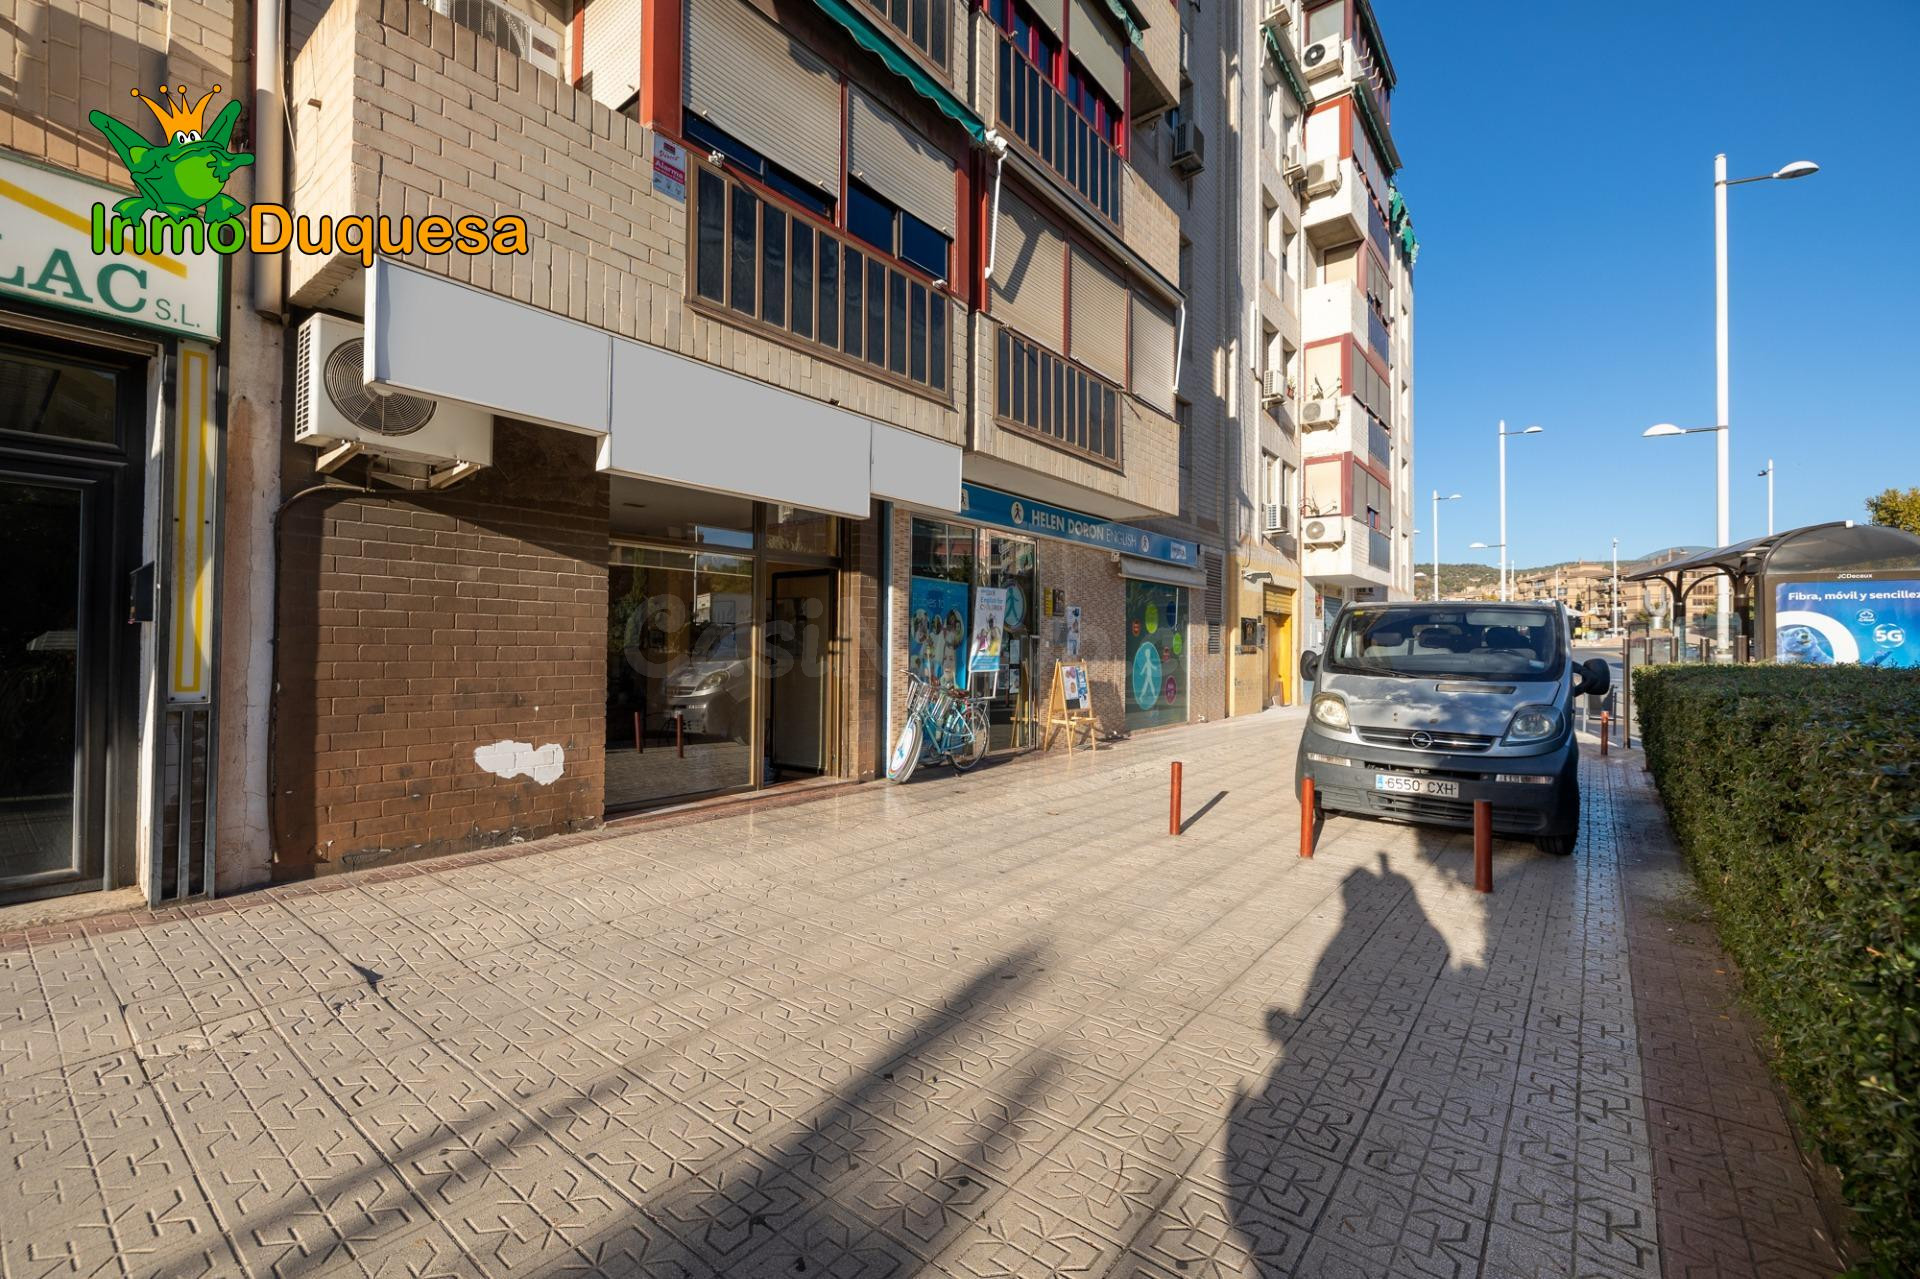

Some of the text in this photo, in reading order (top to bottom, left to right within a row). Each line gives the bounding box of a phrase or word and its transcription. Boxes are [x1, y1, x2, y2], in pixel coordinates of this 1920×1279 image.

[154, 298, 201, 328] S.L.
[1031, 509, 1137, 546] HELEN DORON ENGLISH
[1788, 590, 1920, 601] Fibra, móvil y sencillez
[1875, 629, 1903, 642] 5G
[1387, 777, 1454, 795] 6550 CXH
